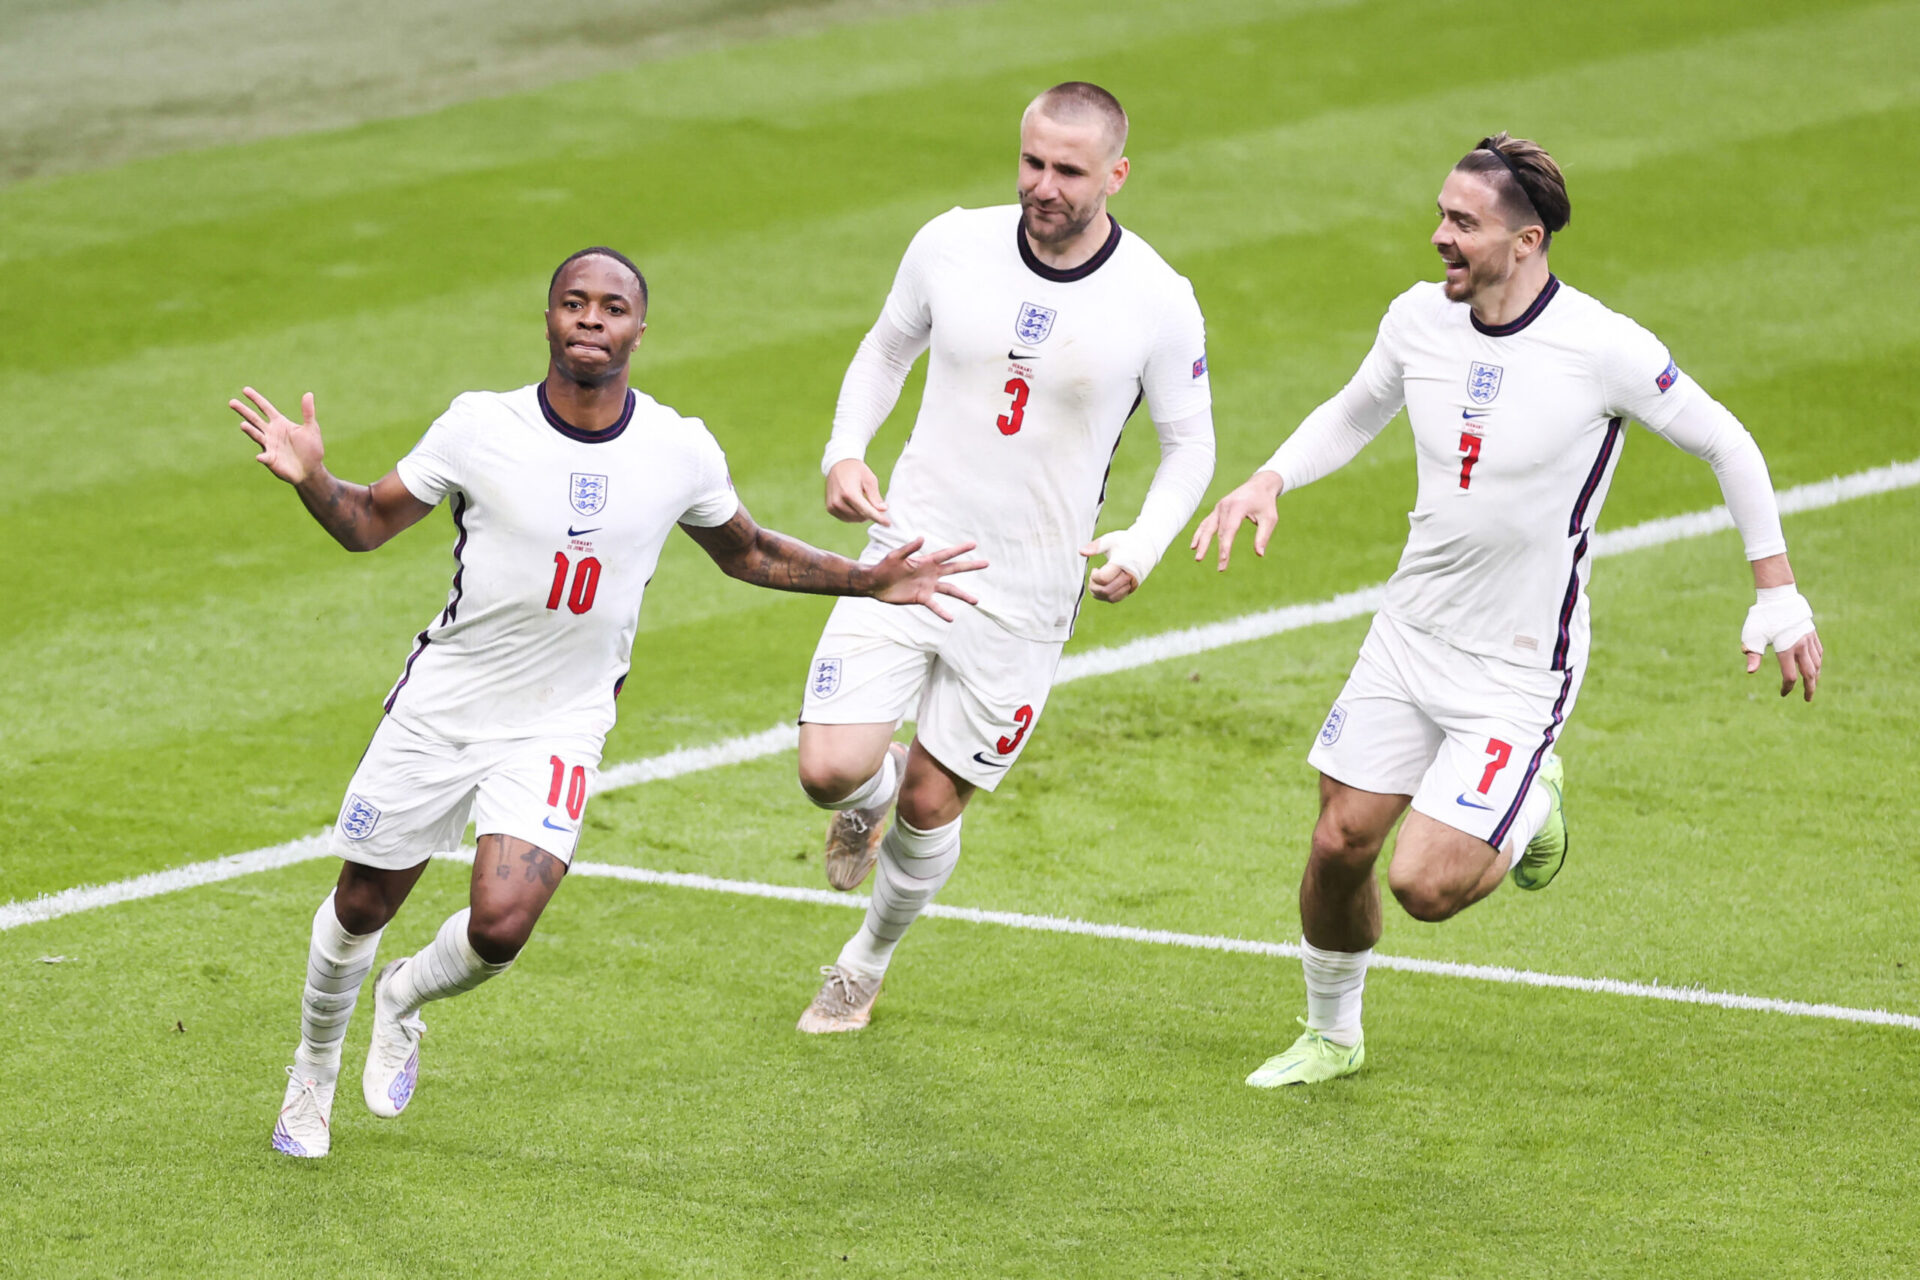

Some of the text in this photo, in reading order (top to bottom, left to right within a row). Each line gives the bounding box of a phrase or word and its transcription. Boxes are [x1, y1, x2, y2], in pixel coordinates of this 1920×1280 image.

[996, 377, 1030, 436] 3
[1458, 431, 1482, 490] 7
[546, 551, 602, 615] 10
[996, 704, 1034, 755] 3
[547, 754, 586, 820] 10
[1476, 737, 1513, 795] 7
